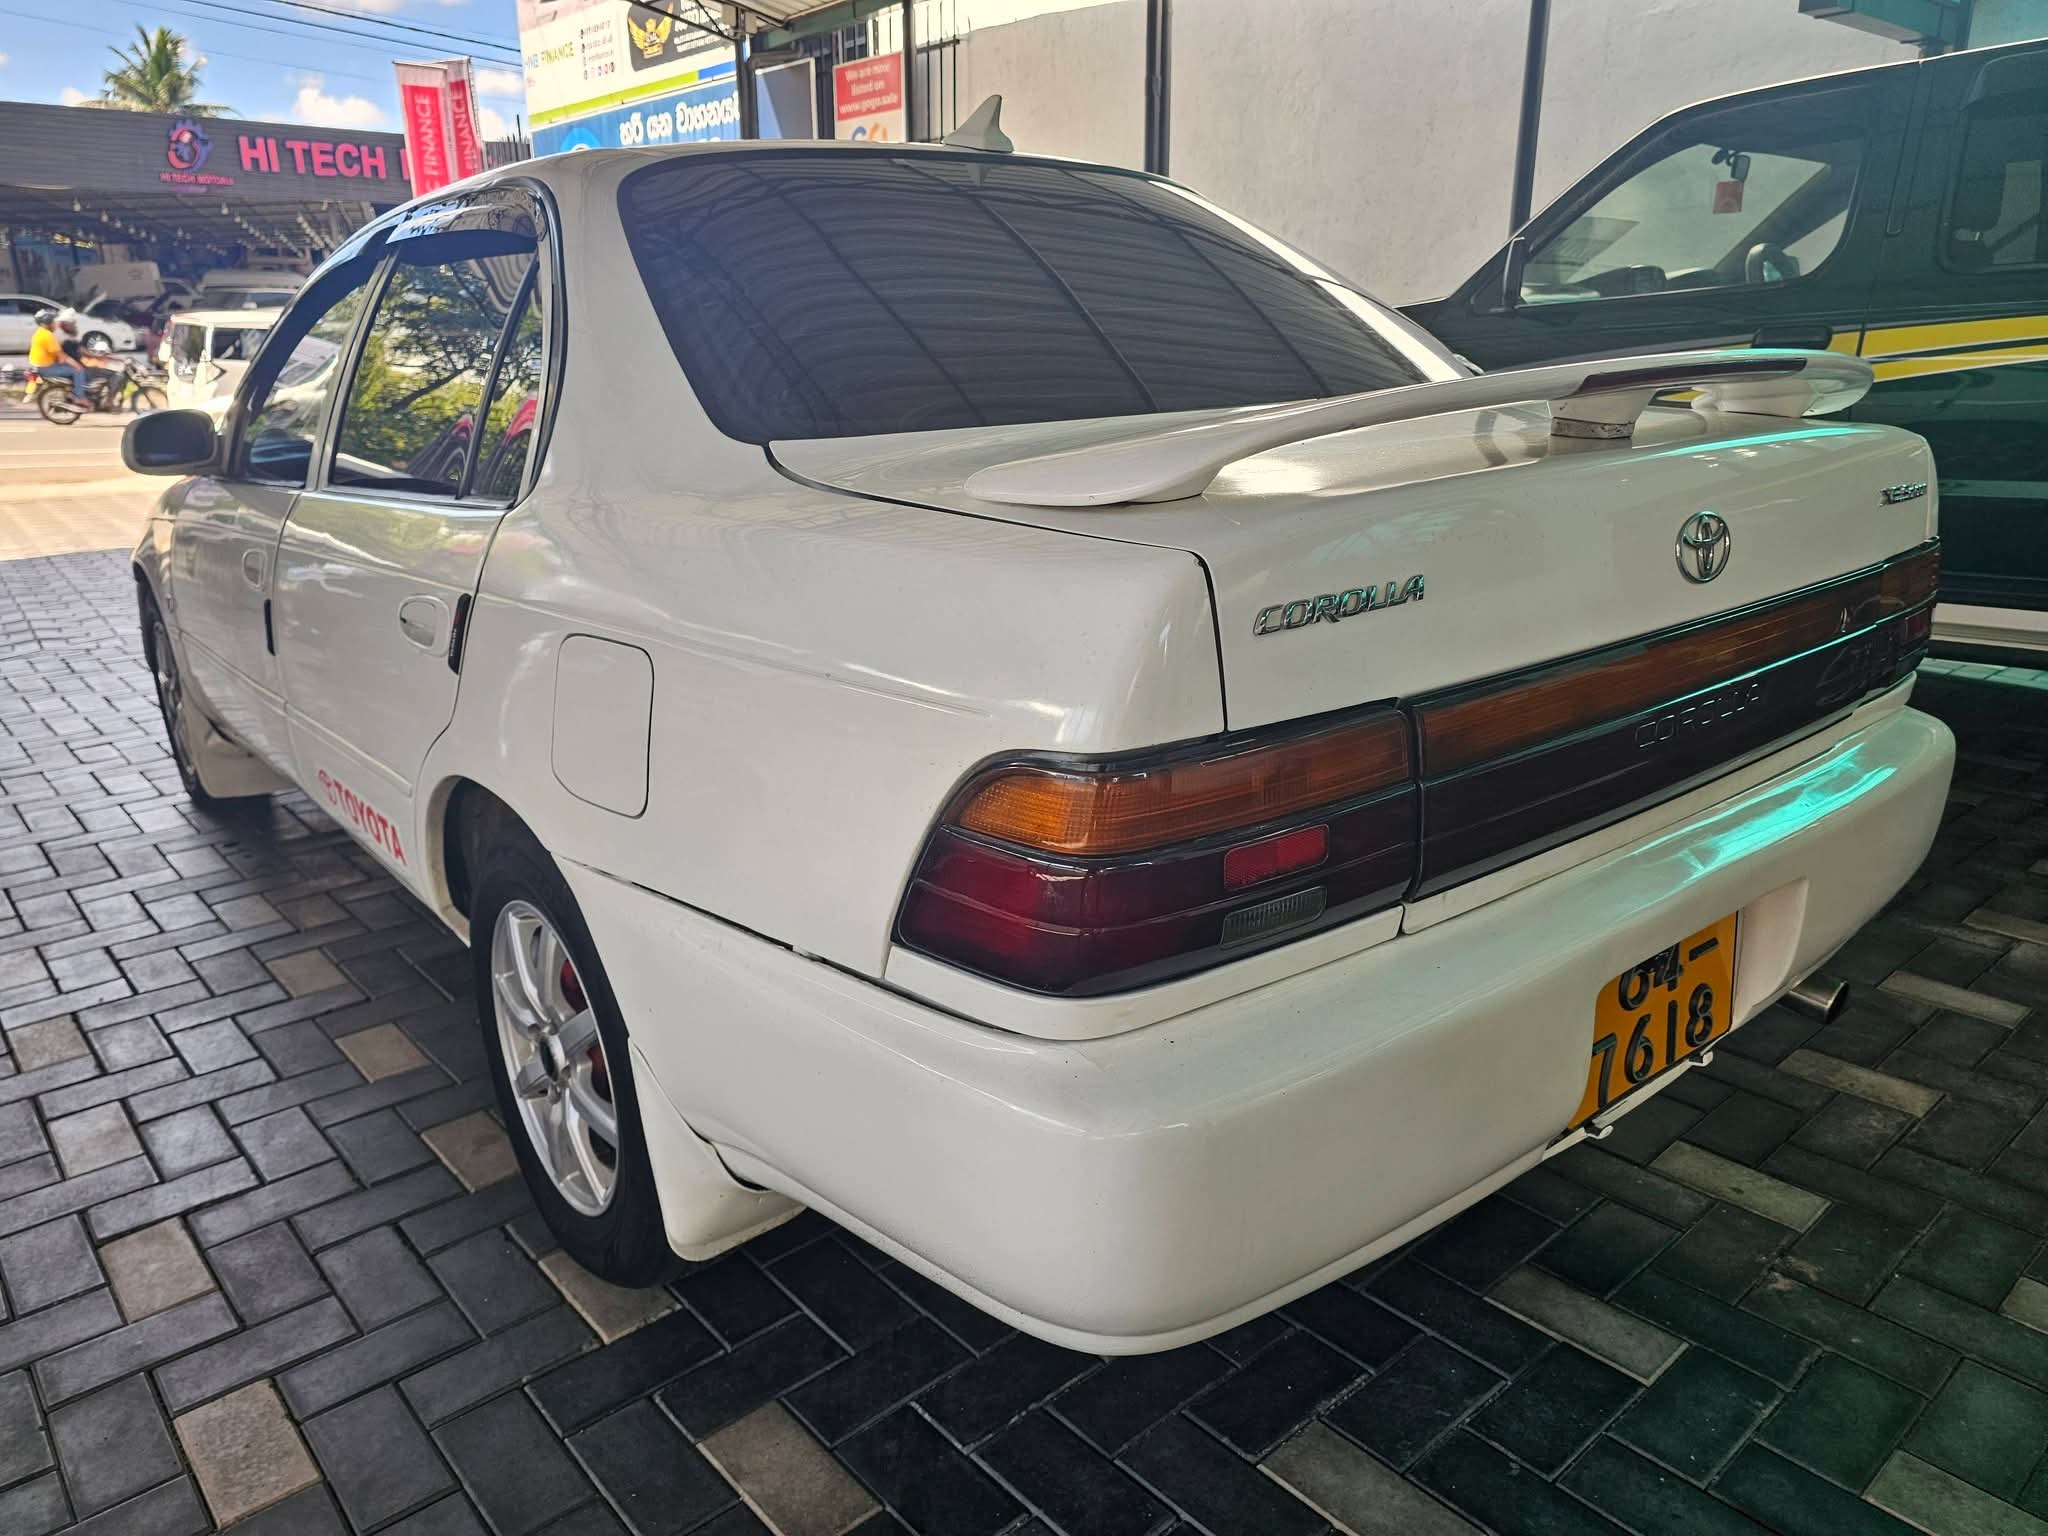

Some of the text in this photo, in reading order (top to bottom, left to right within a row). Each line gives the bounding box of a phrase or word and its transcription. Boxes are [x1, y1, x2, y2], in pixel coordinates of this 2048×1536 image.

[239, 135, 281, 173] HI
[285, 139, 387, 179] TECH
[414, 93, 440, 176] FINANCE
[452, 86, 480, 171] FINANCE
[1253, 574, 1424, 636] COROLLA
[333, 779, 407, 867] TOYOTA
[1592, 983, 1713, 1109] 7618
